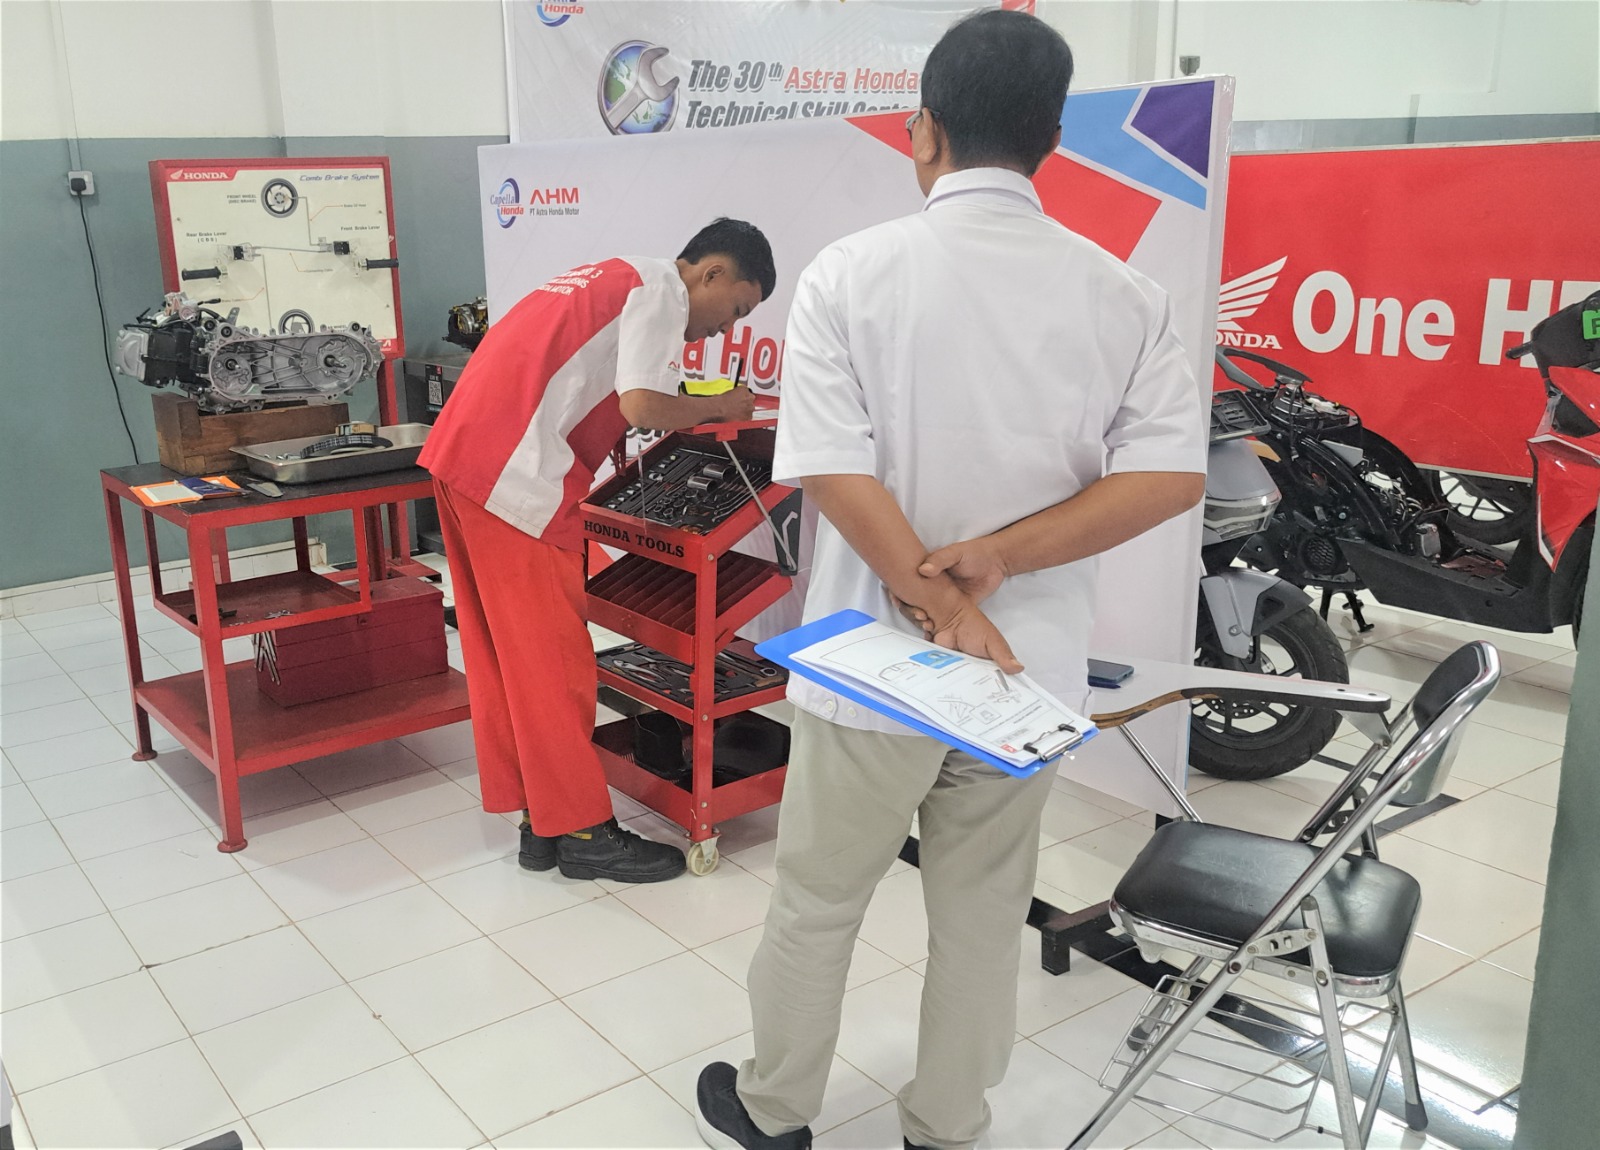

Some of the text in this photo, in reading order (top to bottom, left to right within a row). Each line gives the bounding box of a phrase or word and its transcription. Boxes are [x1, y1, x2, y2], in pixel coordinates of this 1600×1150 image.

[544, 4, 584, 14] Honda
[688, 60, 731, 91] The
[784, 66, 847, 93] Astra
[853, 68, 919, 93] Honda
[685, 101, 798, 128] Technical
[183, 172, 229, 180] HONDA
[351, 173, 380, 181] System
[490, 193, 516, 207] Capella
[530, 188, 579, 205] AHM
[500, 206, 524, 215] Honda
[565, 207, 579, 215] Motor
[590, 269, 604, 279] 3
[1293, 270, 1455, 361] One
[1215, 331, 1283, 350] NDA
[584, 521, 685, 558] HONDA TOOLS
